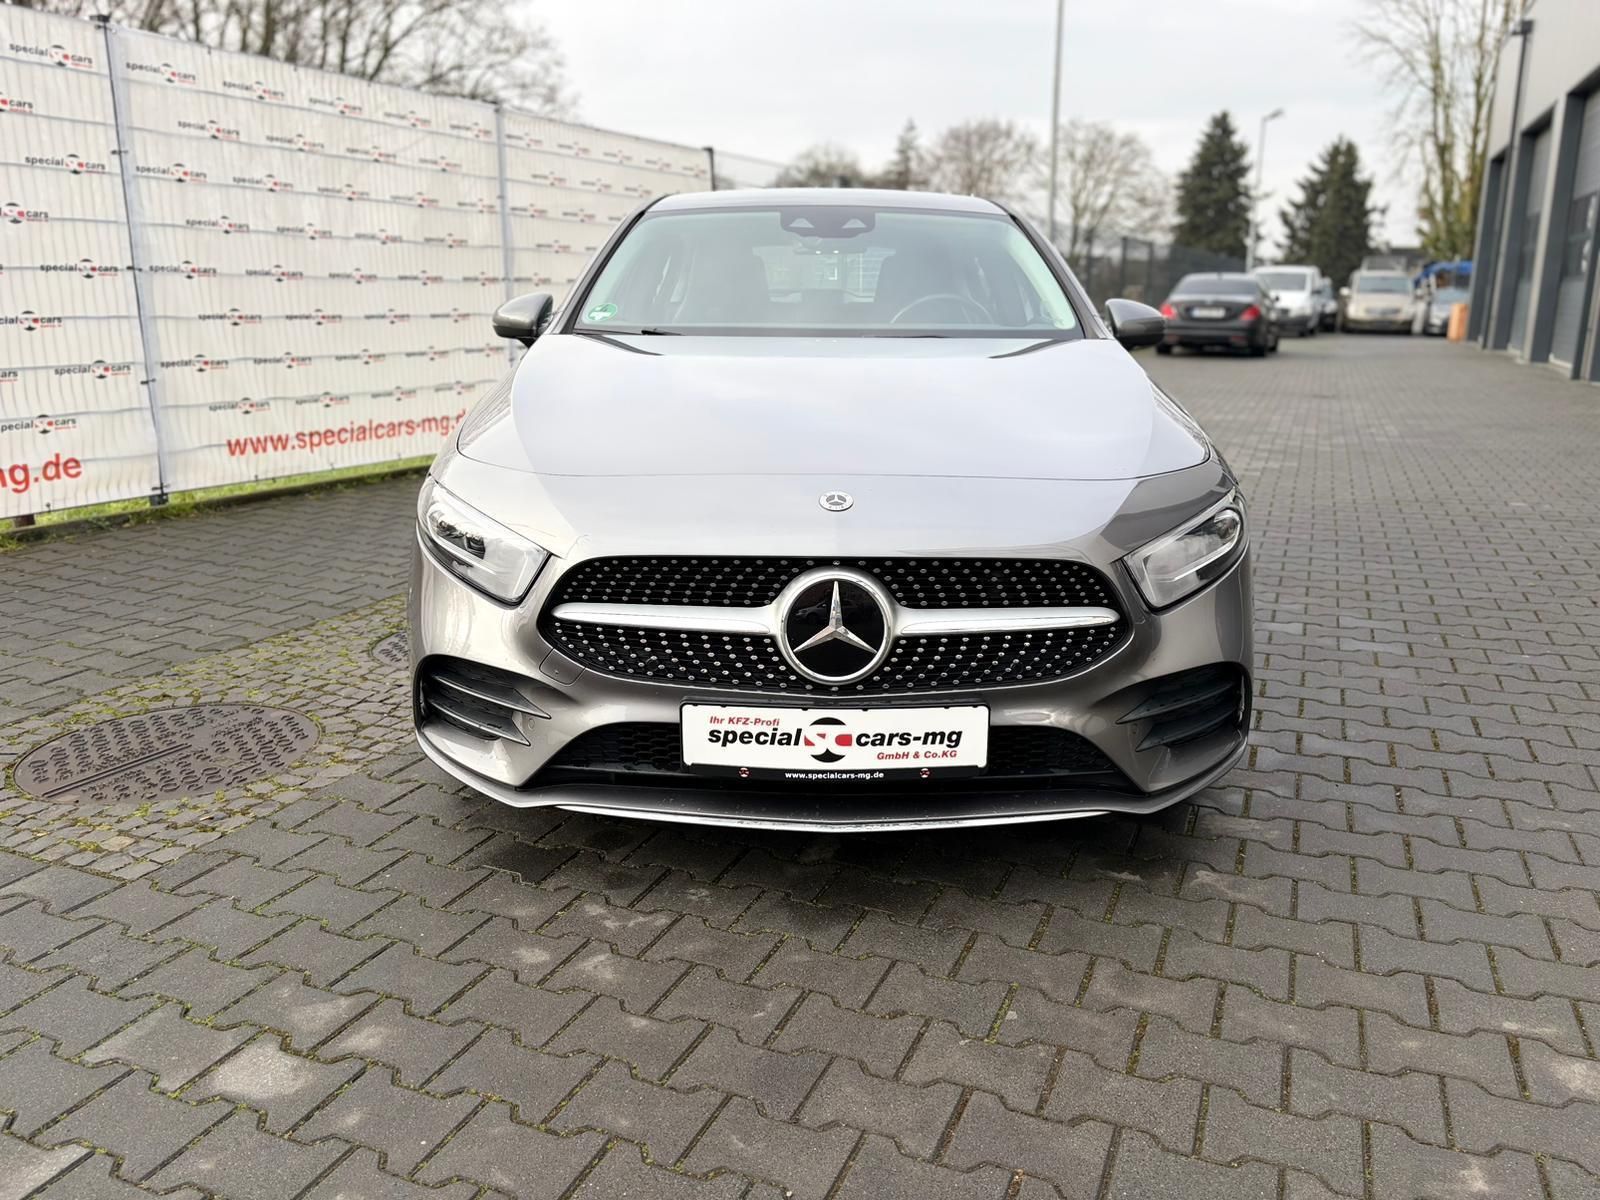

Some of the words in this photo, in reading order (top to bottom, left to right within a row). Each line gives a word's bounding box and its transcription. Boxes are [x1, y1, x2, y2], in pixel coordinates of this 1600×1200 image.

[9, 41, 49, 57] special
[71, 54, 93, 64] cars
[25, 155, 64, 167] special
[85, 161, 106, 171] cars
[26, 209, 49, 218] cars
[40, 263, 77, 273] special
[97, 264, 119, 273] cars
[0, 316, 18, 325] cial
[40, 316, 62, 324] cars
[0, 370, 18, 378] ars
[54, 365, 91, 375] special
[111, 364, 131, 372] cars
[0, 420, 34, 433] pecial
[54, 417, 76, 426] cars
[709, 716, 725, 725] Ihr
[728, 716, 780, 727] KFZ-Profi
[707, 727, 803, 748] special
[855, 730, 963, 749] cars-mg
[876, 751, 910, 761] GmbH
[912, 751, 920, 759] &
[923, 750, 958, 759] Co.KG
[784, 771, 885, 781] www.specialcars-mg.de
